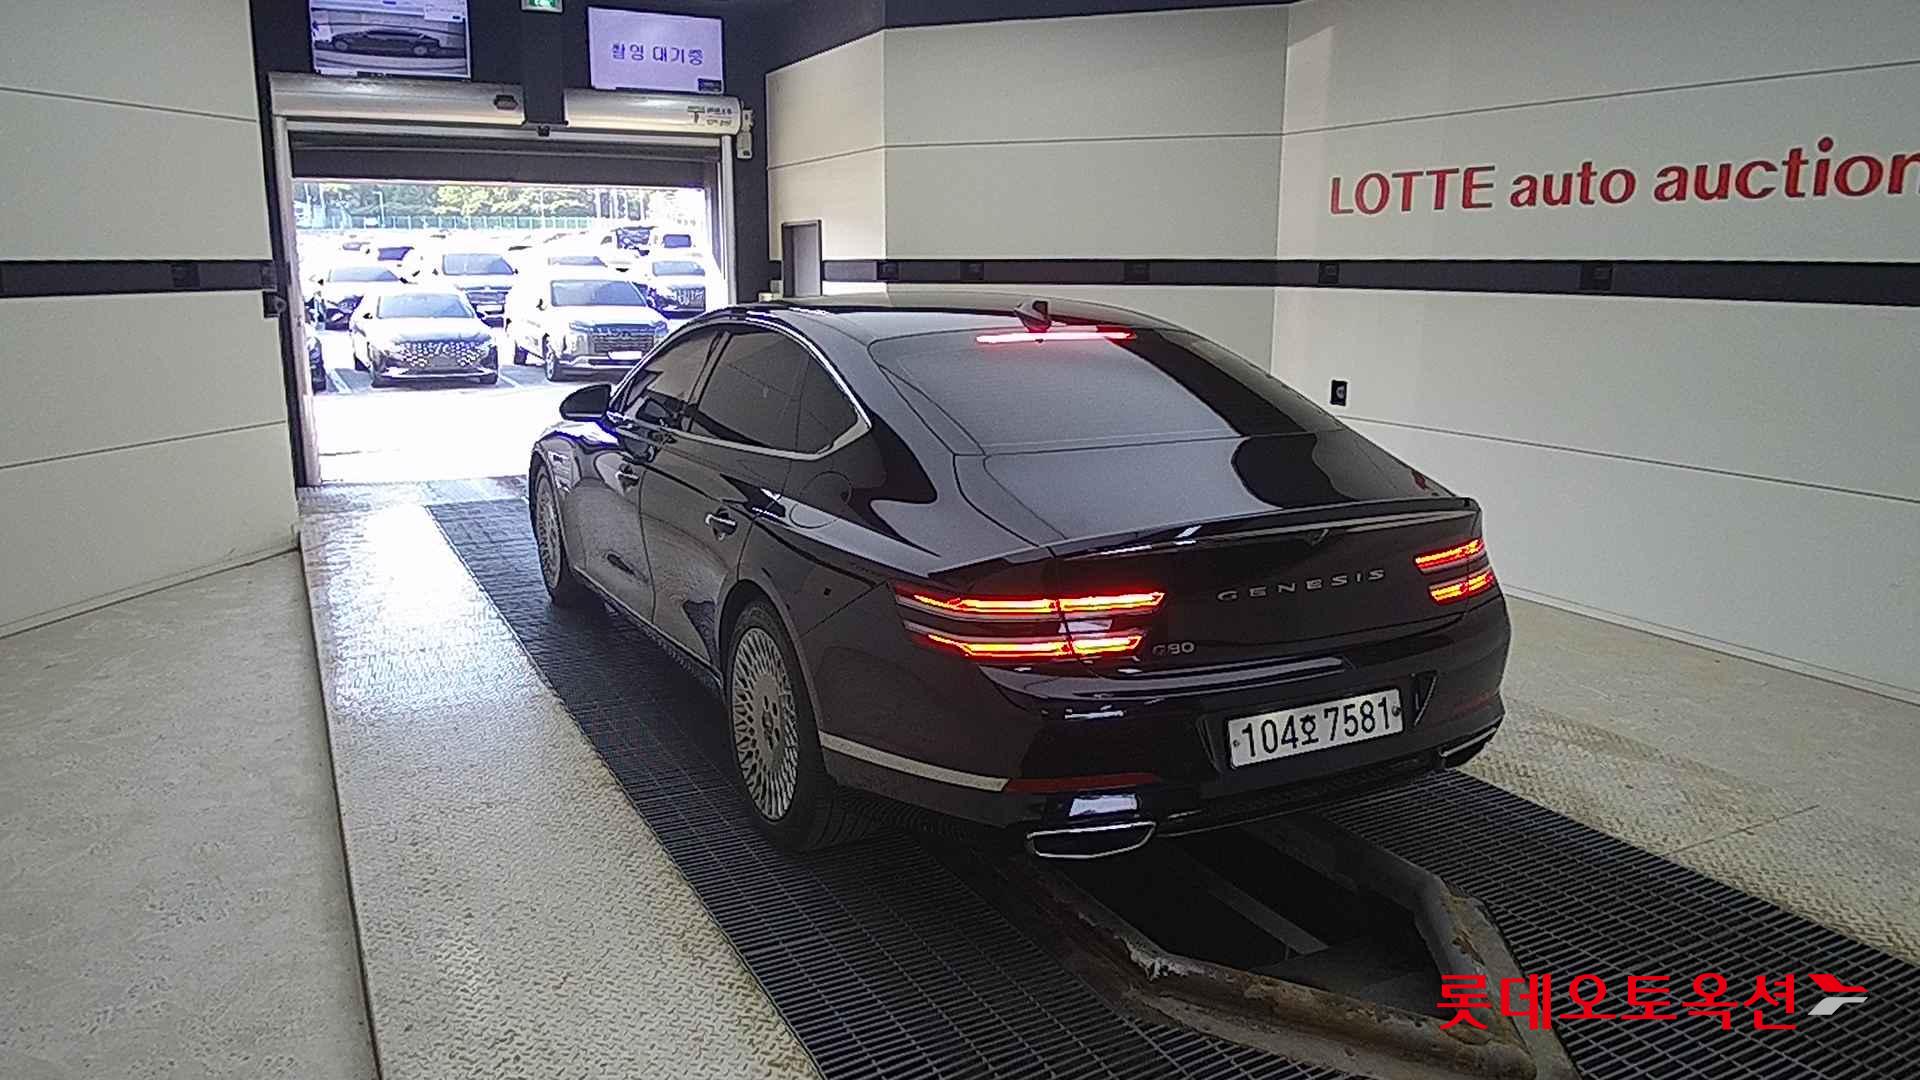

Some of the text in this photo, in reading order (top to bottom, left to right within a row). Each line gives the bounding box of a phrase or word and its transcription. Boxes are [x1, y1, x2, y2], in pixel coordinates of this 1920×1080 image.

[652, 46, 704, 66] 대기중
[1330, 136, 1920, 215] LOTTE auto auction
[1217, 569, 1385, 601] GENESIS
